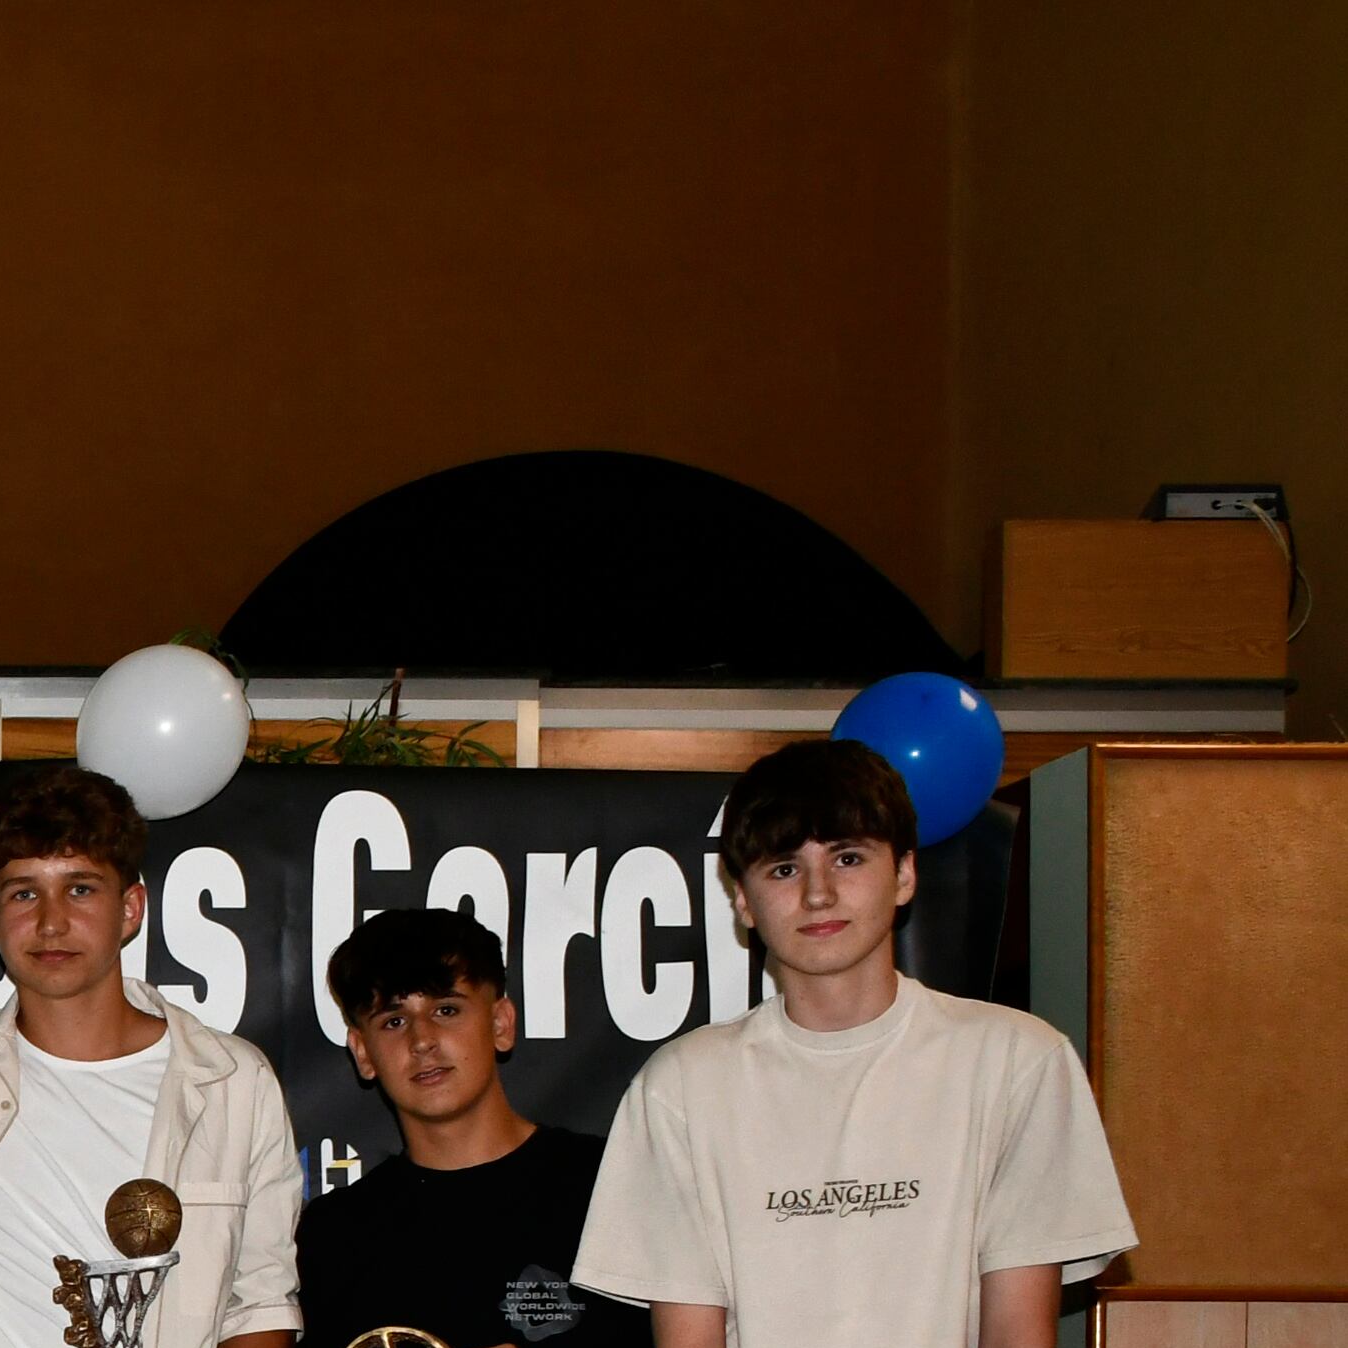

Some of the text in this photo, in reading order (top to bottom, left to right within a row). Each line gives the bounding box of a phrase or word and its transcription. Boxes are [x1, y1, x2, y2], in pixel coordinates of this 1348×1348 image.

[765, 1179, 920, 1210] LOS ANGELES
[838, 1199, 911, 1218] California
[506, 1281, 569, 1289] NEW YOR
[506, 1292, 558, 1300] GLOBAL
